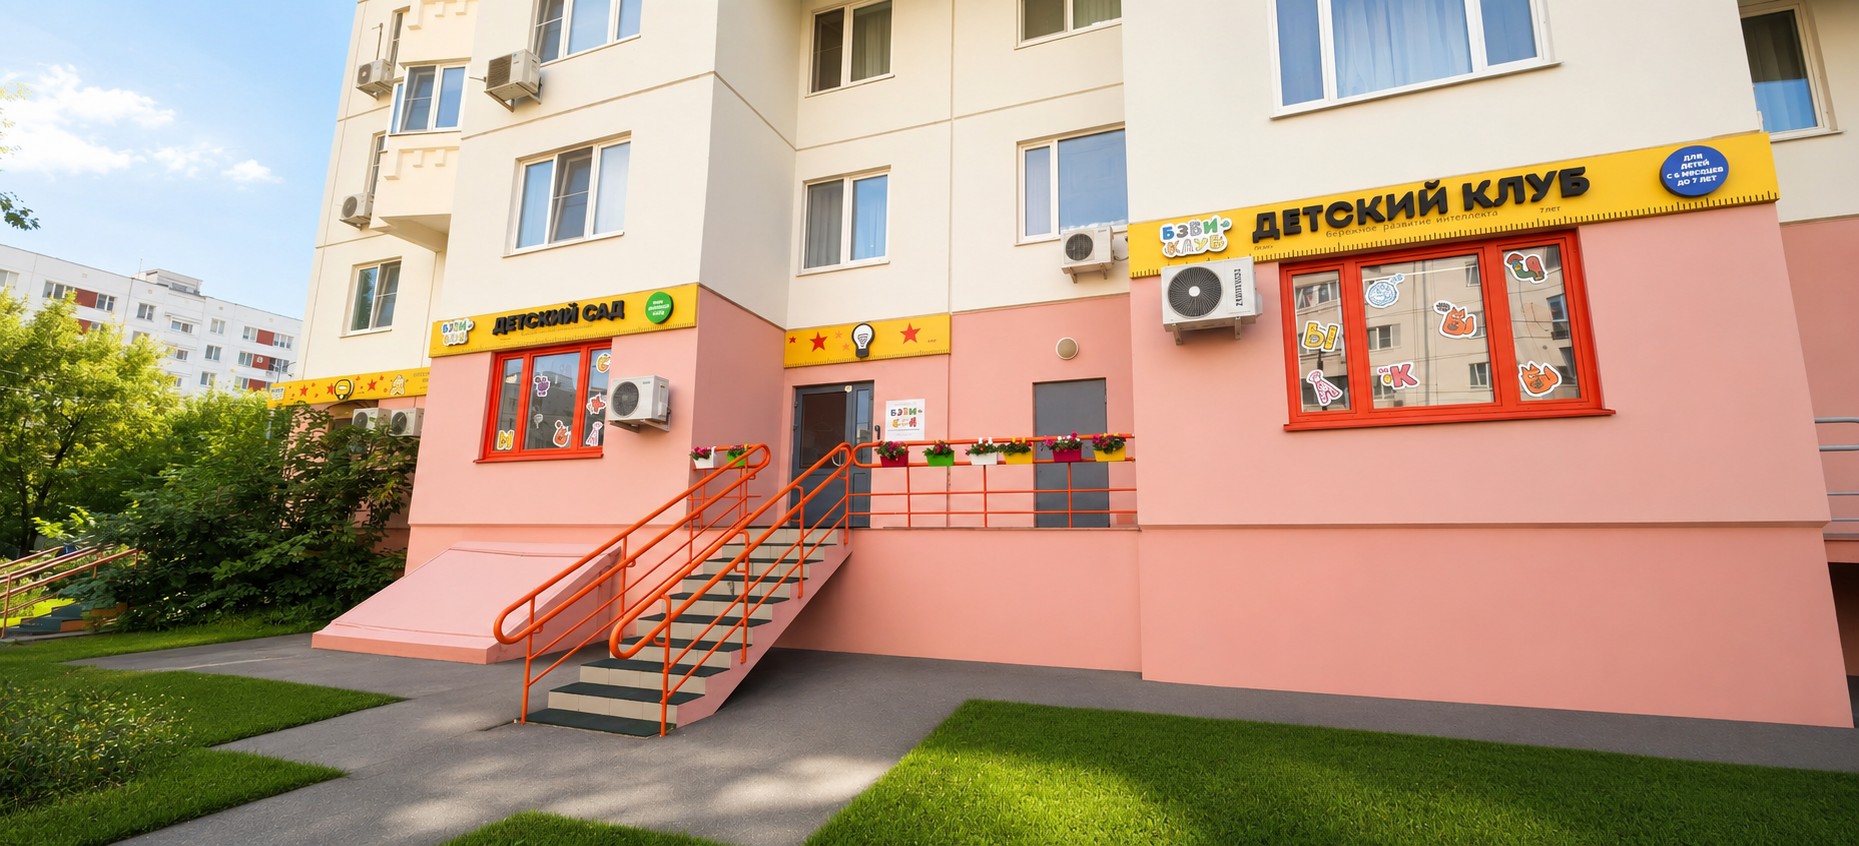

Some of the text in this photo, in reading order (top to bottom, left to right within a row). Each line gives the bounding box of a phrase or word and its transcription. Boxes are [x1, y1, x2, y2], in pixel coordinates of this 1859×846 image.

[1252, 166, 1590, 244] ДЕТСКИЙ КЛУБ
[492, 302, 579, 336] ДЕТСКИЙ
[582, 300, 625, 322] САД
